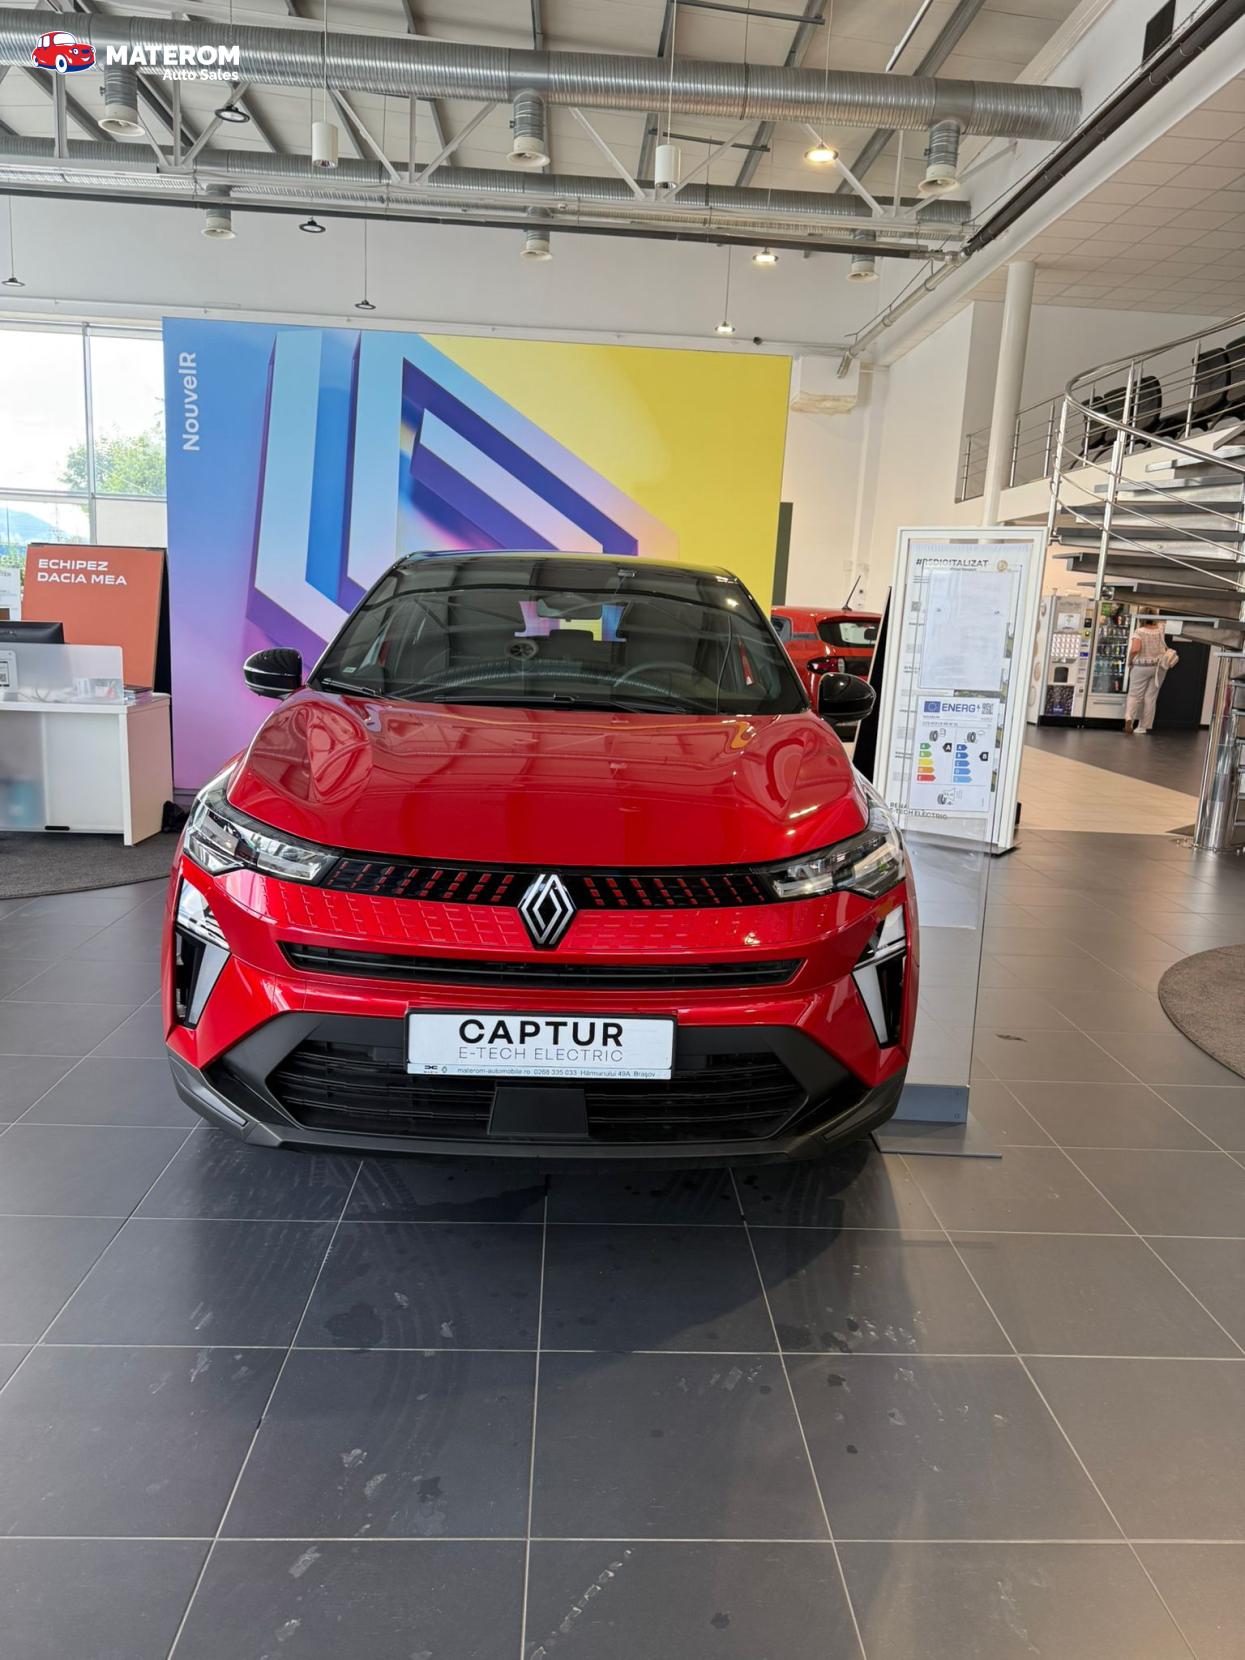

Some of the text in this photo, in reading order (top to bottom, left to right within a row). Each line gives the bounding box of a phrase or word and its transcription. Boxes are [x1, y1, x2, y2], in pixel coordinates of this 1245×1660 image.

[38, 559, 108, 571] ECHIPEZ
[37, 572, 127, 585] DACIA MEA
[459, 1019, 623, 1046] CAPTUR
[459, 1047, 623, 1062] E-TECH ELECTRIC
